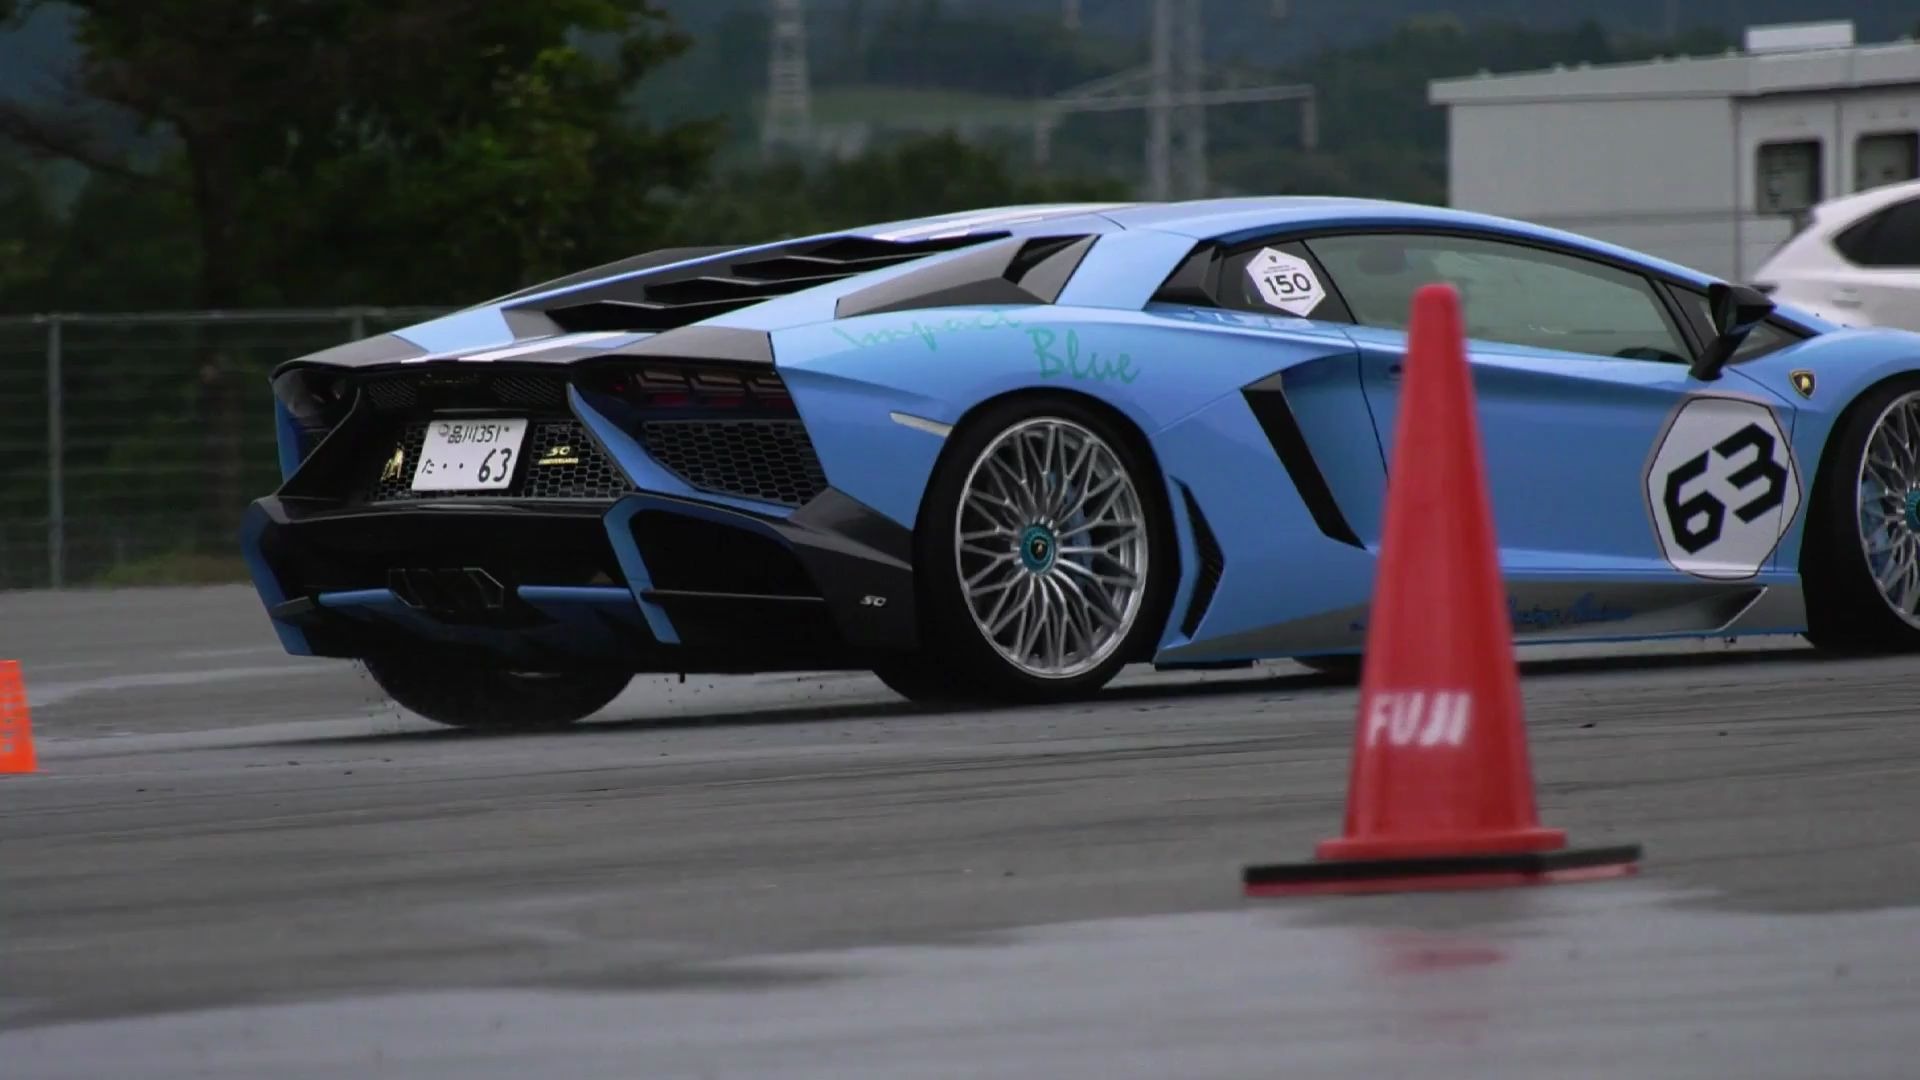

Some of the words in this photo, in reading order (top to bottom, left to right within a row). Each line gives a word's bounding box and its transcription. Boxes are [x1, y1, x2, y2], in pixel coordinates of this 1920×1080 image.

[1263, 272, 1312, 296] 150
[1025, 328, 1142, 385] Blue
[477, 447, 513, 483] 63
[1662, 421, 1789, 556] 63
[1365, 691, 1472, 748] FUJI
